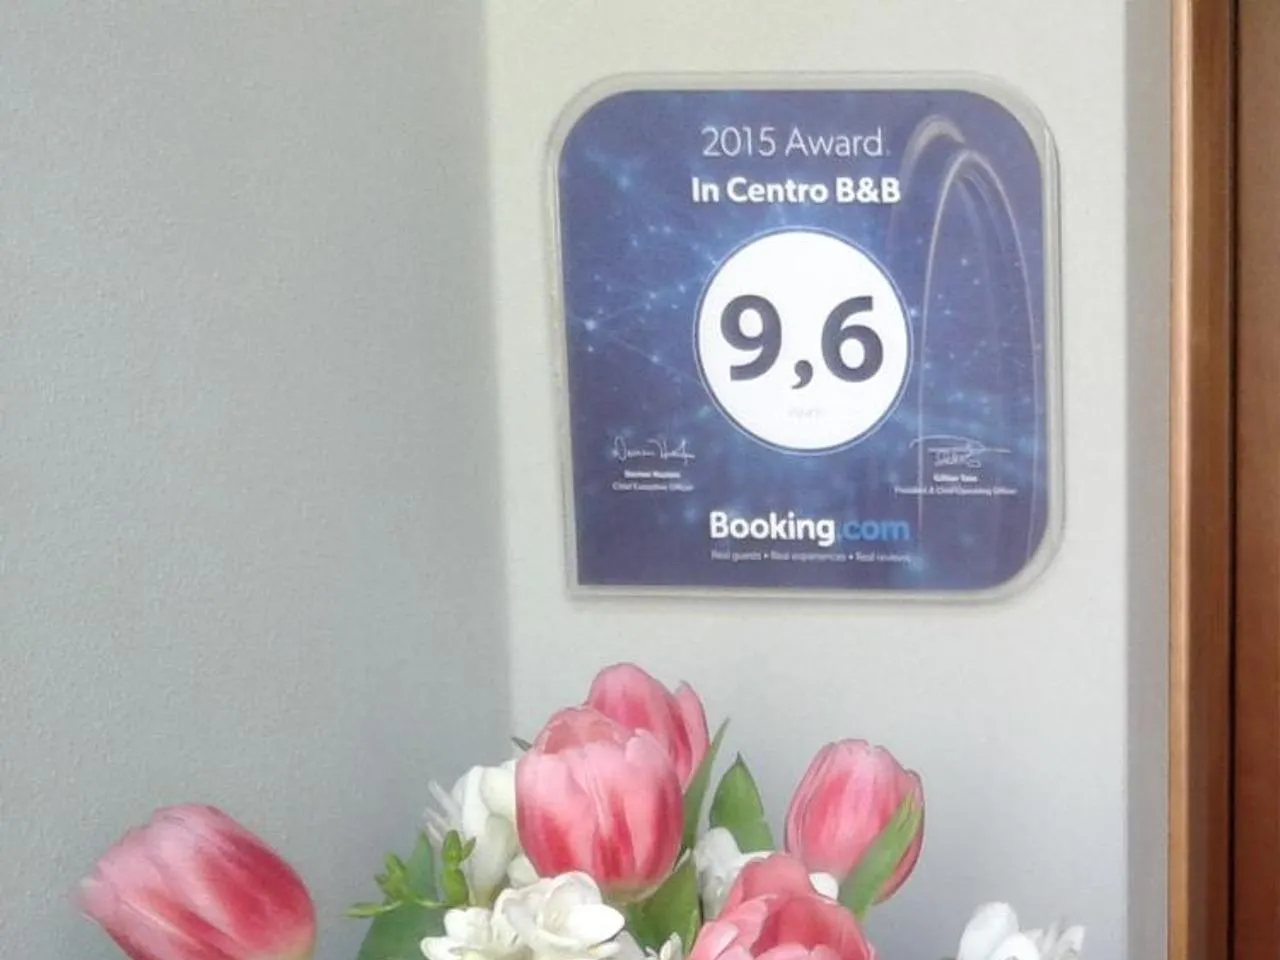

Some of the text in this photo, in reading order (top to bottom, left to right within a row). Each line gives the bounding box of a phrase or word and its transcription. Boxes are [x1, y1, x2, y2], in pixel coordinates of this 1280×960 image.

[702, 126, 776, 157] 2015
[691, 176, 900, 204] In Centro B&B
[720, 294, 884, 390] 9,6
[709, 510, 910, 547] Booking.com
